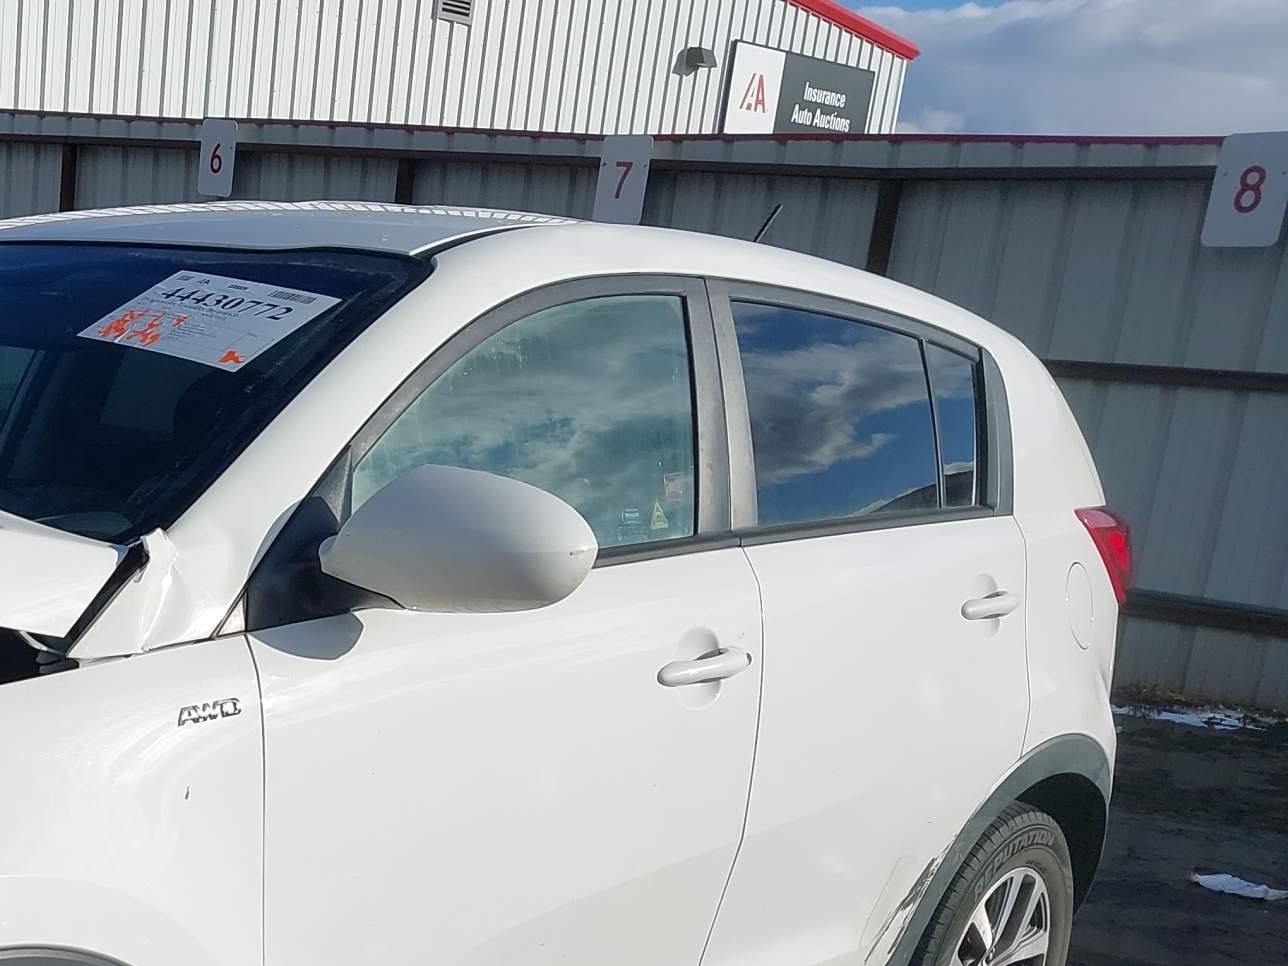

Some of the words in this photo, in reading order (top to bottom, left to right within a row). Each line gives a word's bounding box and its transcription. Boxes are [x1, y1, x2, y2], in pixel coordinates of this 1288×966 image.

[803, 81, 847, 108] Insurance
[791, 104, 813, 126] Auto
[813, 108, 851, 133] Auctions
[210, 143, 222, 174] 6
[615, 161, 635, 199] 7
[1234, 165, 1266, 213] 8
[161, 288, 293, 320] 44430772
[177, 697, 242, 727] AWD
[973, 830, 1056, 904] REPUTATION
